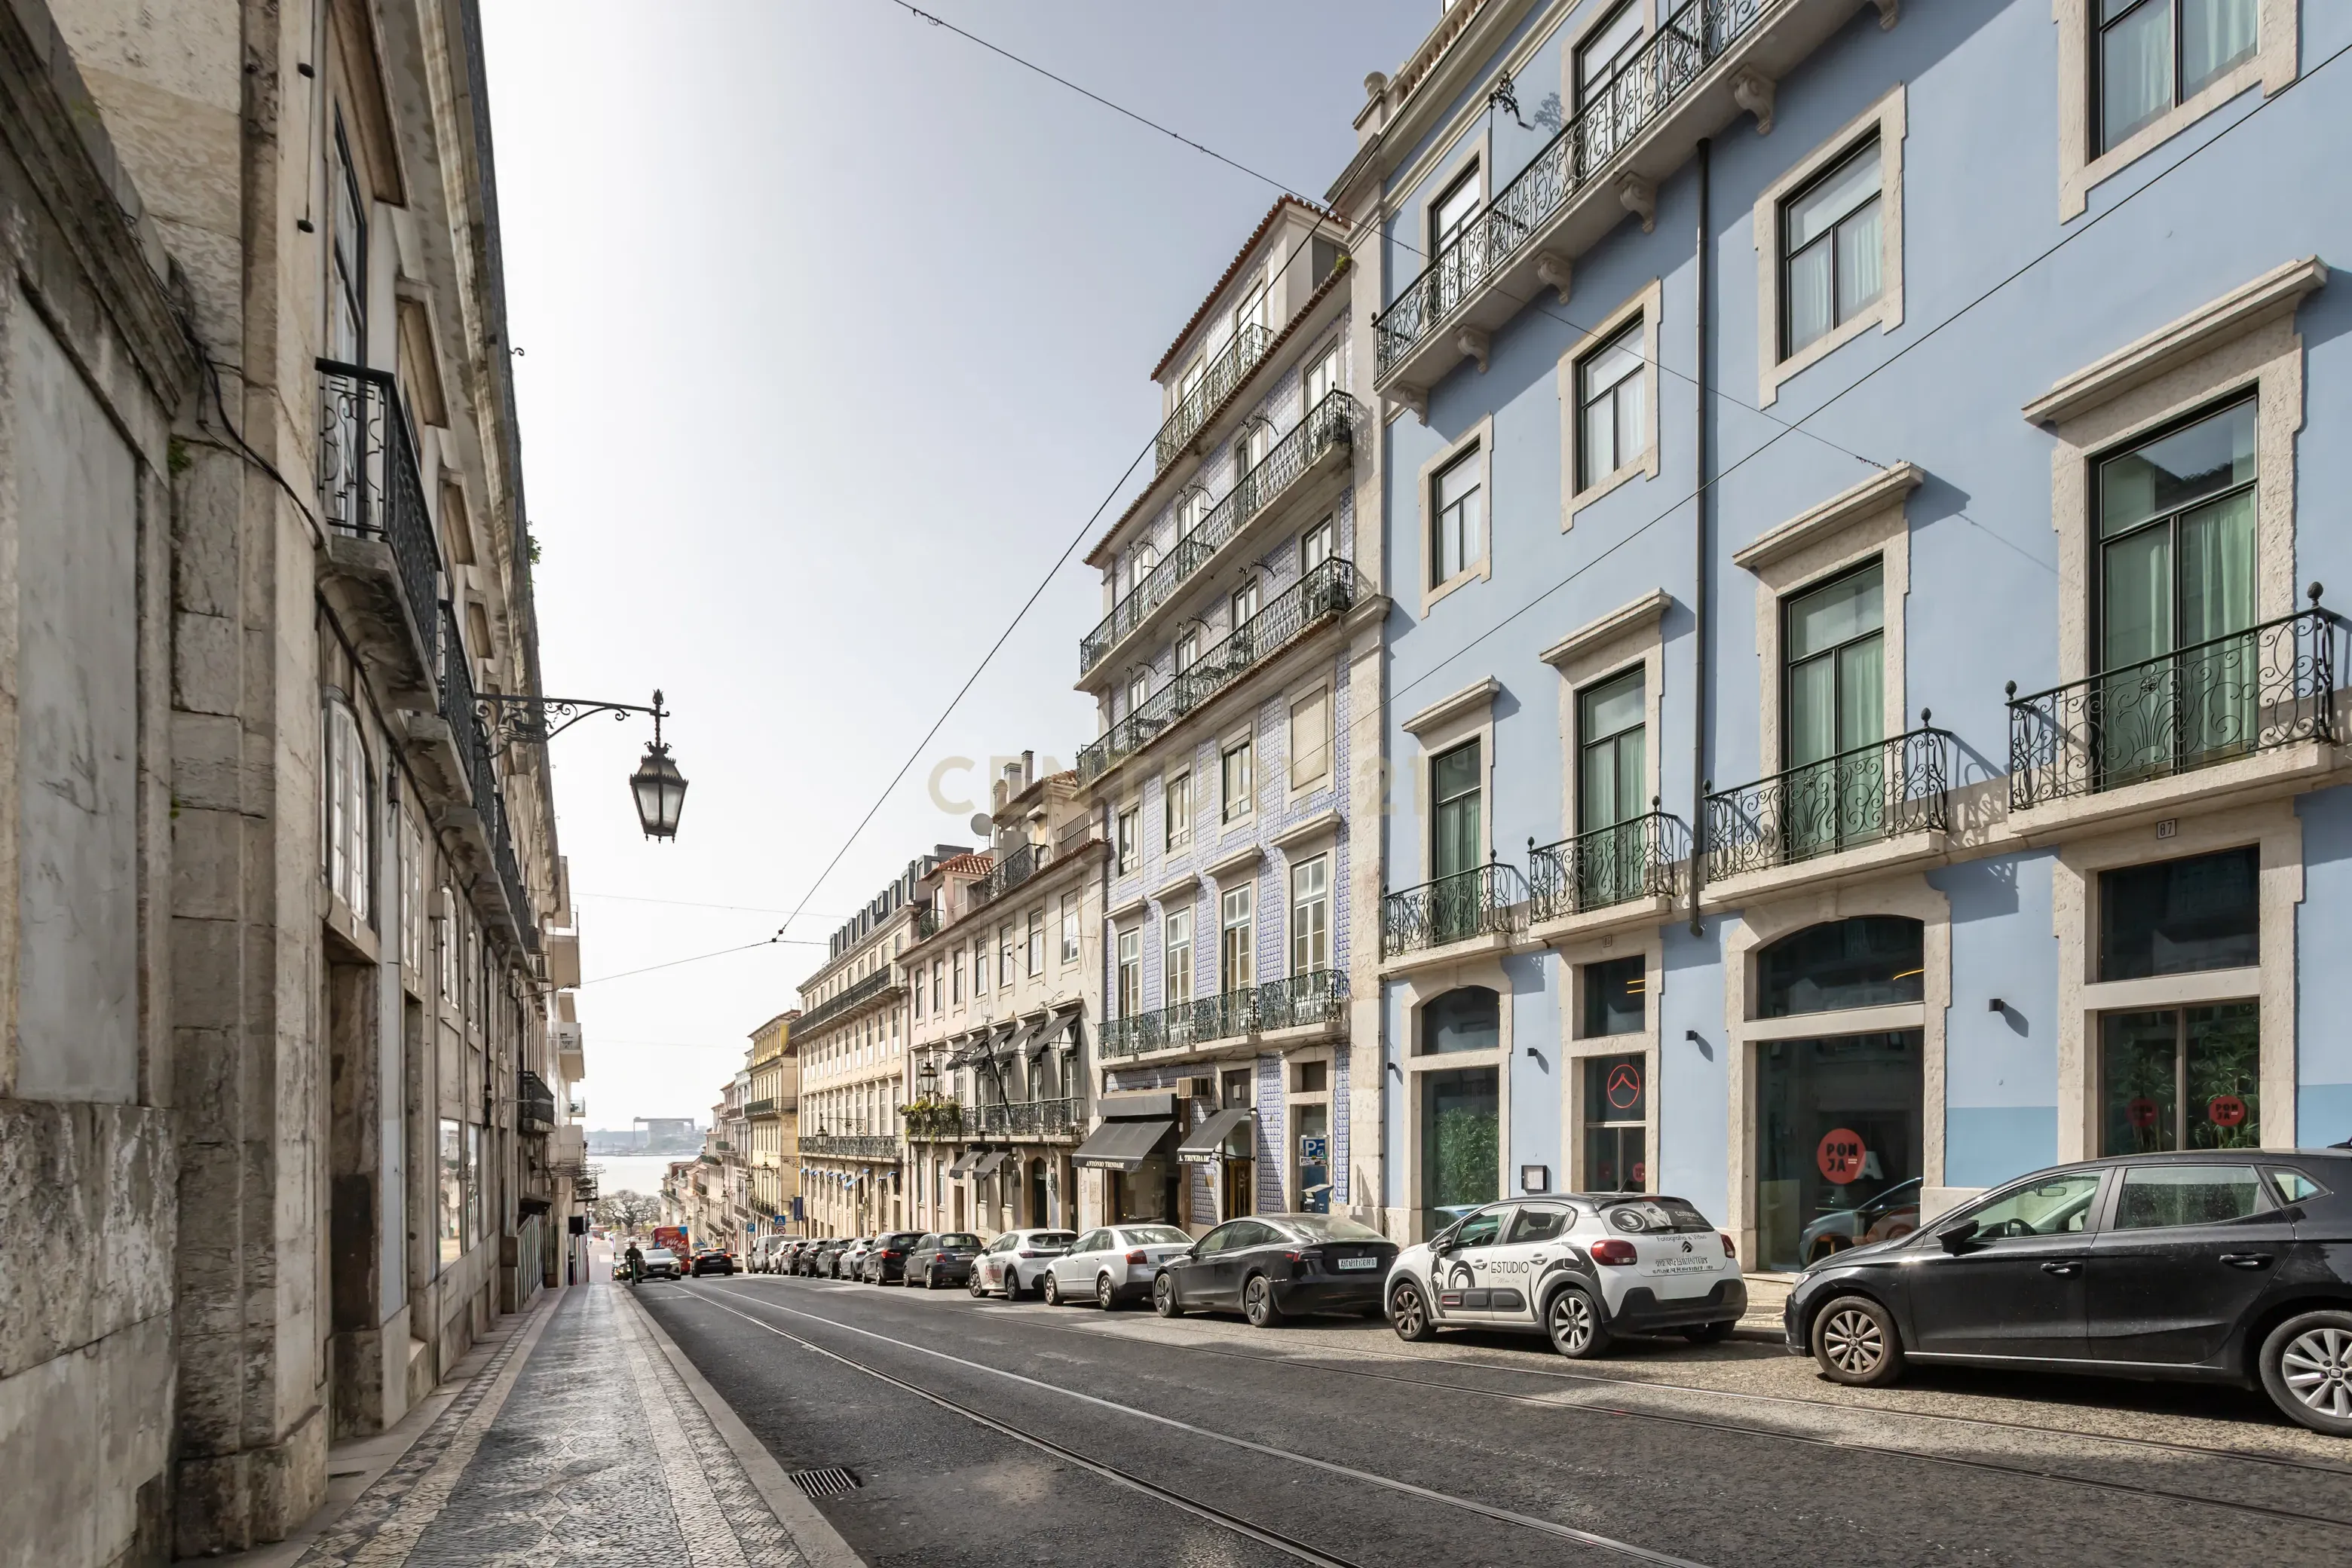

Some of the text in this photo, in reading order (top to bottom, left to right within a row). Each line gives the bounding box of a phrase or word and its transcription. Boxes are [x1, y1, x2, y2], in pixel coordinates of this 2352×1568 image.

[2160, 822, 2172, 836] 87
[1306, 1140, 1317, 1156] P
[1826, 1143, 1857, 1156] PON
[1827, 1159, 1846, 1171] JA
[1491, 1261, 1529, 1273] ESTÚDIO
